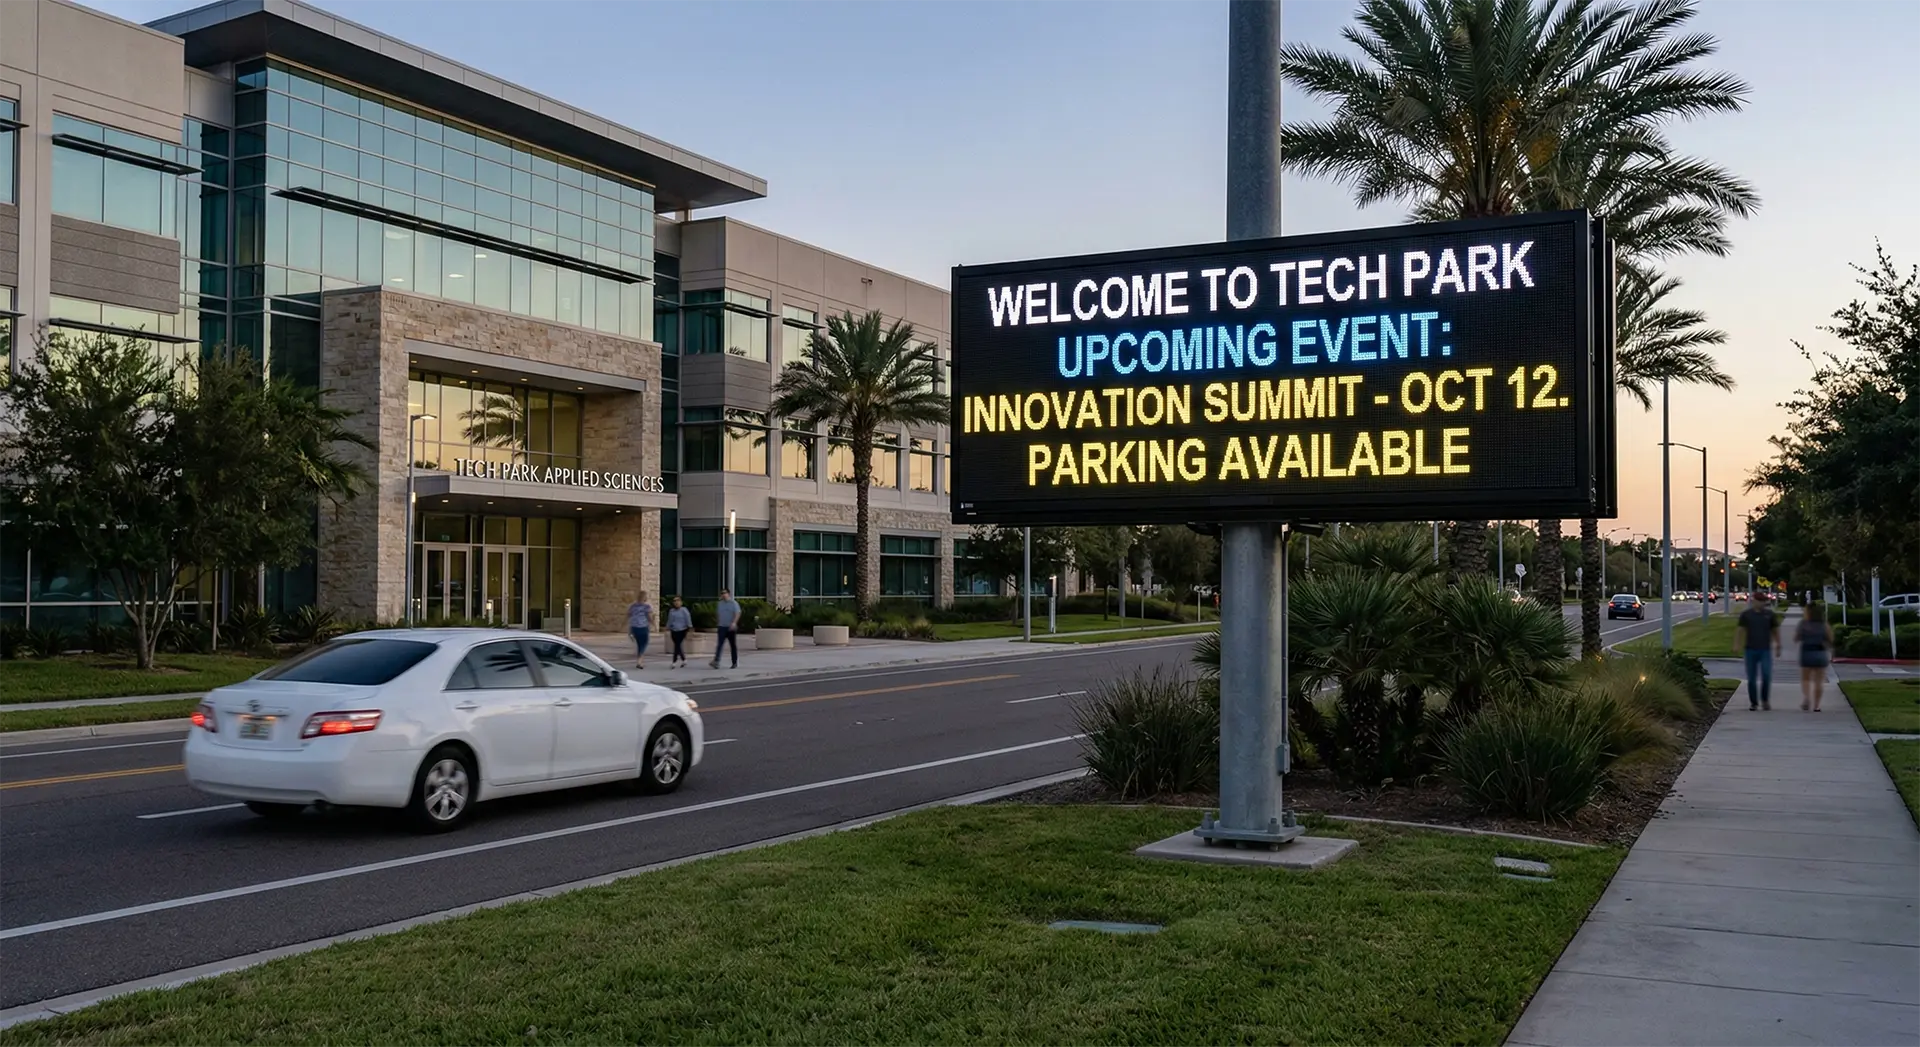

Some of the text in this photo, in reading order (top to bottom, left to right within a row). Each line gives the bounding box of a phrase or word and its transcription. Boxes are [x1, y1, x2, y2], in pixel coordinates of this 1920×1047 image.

[987, 240, 1535, 327] WELCOME TO TECH PARK
[1058, 311, 1451, 378] UPCOMING EVENT:
[964, 364, 1569, 433] INNOVATION SUMMIT - OCT 12.
[456, 458, 665, 493] TECH PARK APPLIED SCIENCES
[1028, 427, 1471, 486] PARKING AVAILABLE
